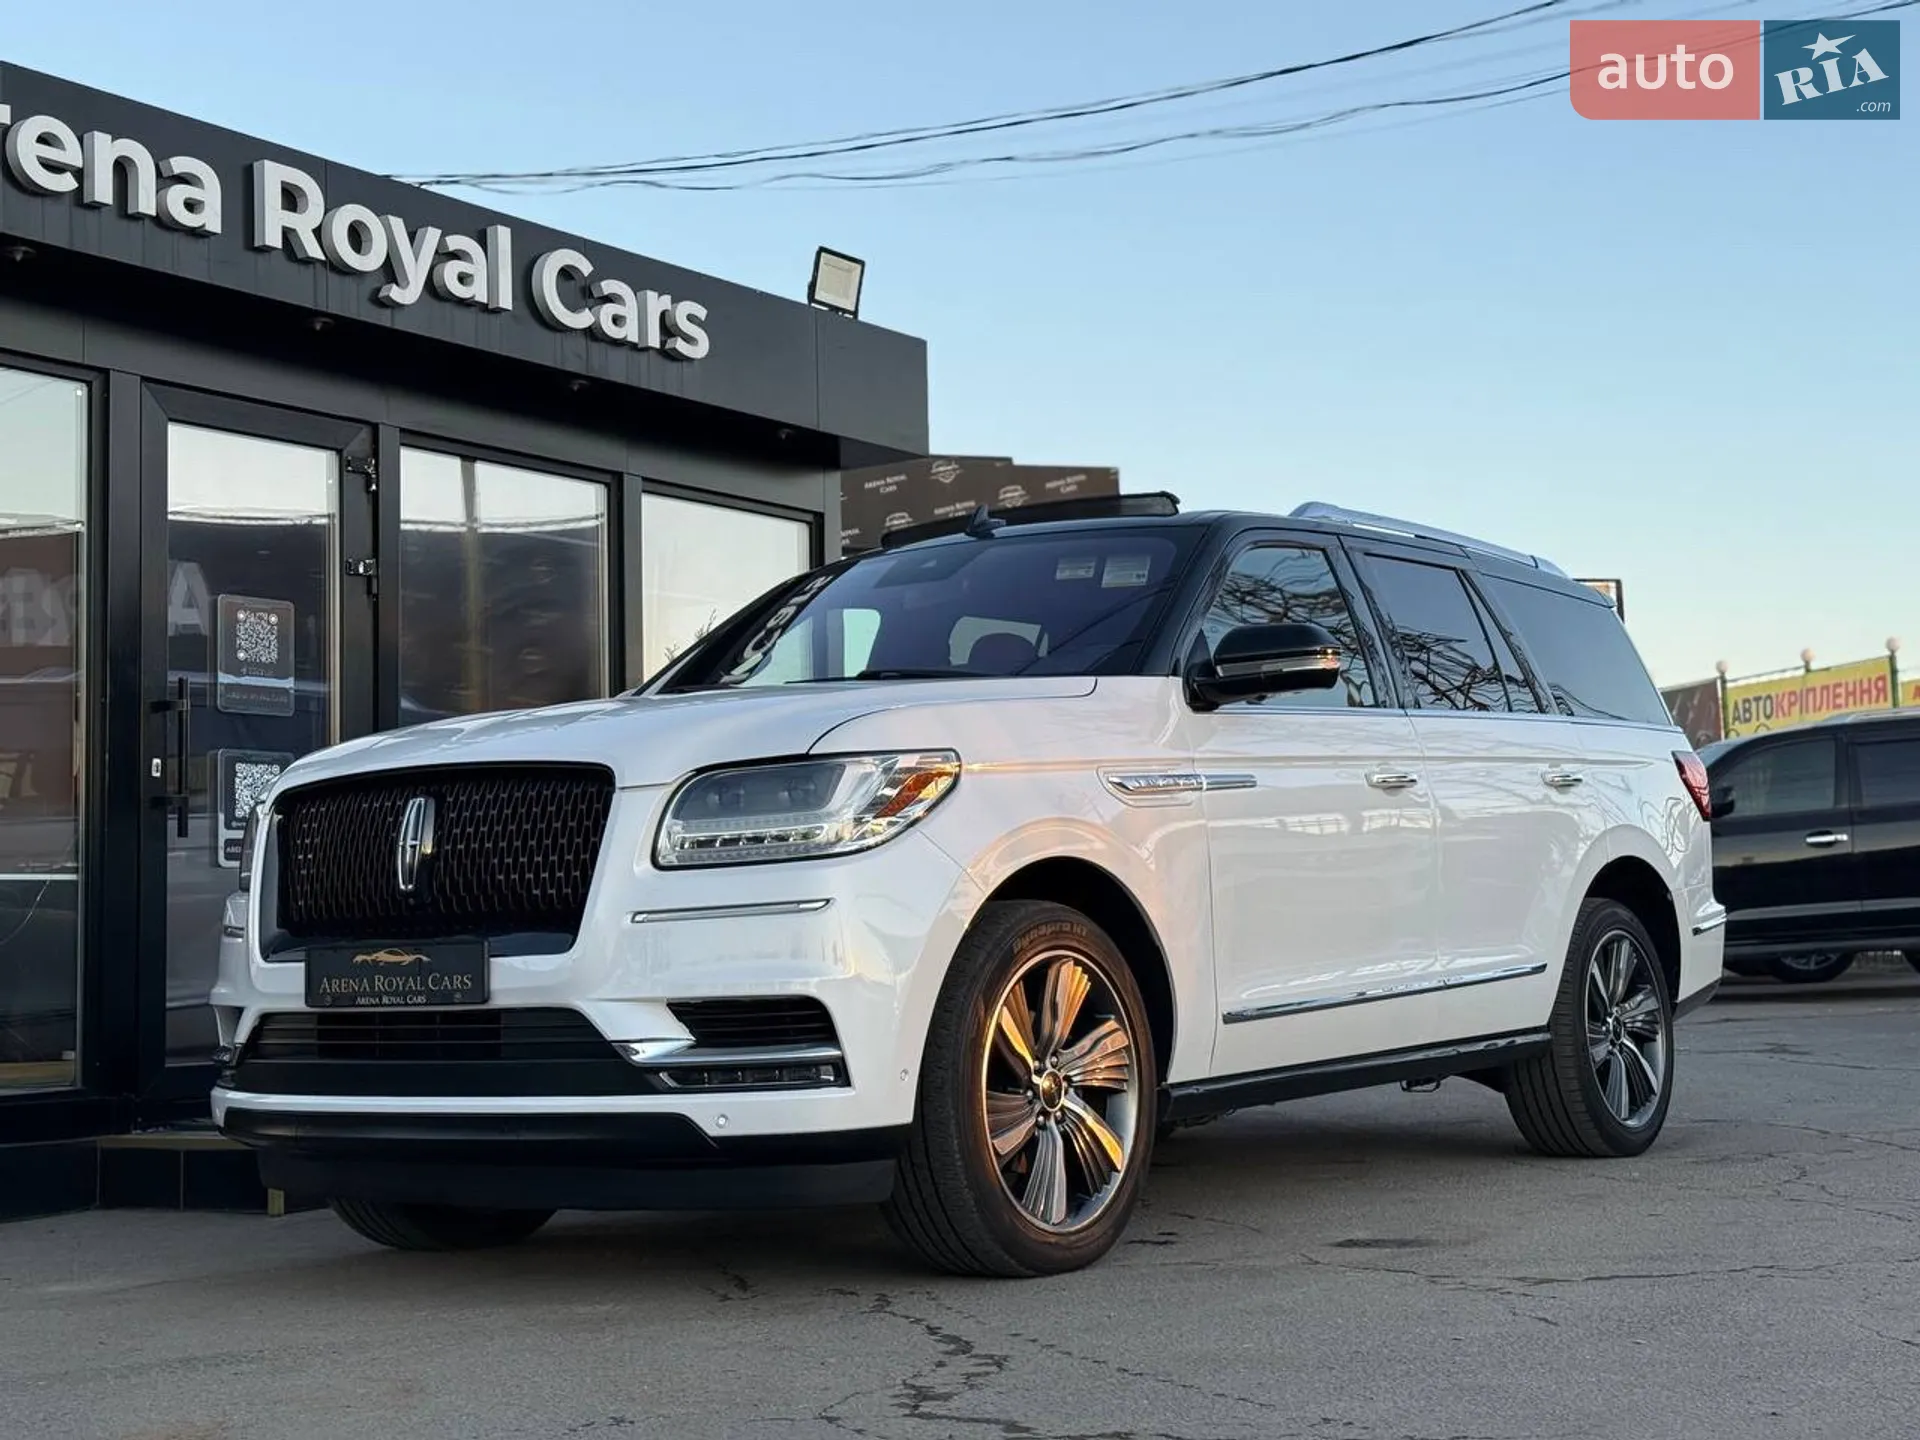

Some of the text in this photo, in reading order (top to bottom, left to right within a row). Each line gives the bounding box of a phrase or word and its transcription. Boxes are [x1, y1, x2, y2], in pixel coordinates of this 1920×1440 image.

[0, 107, 711, 361] ena Royal Cars
[1731, 673, 1889, 725] АВТОКРІПЛЕННЯ
[319, 971, 472, 994] ARENA ROYAL CARS
